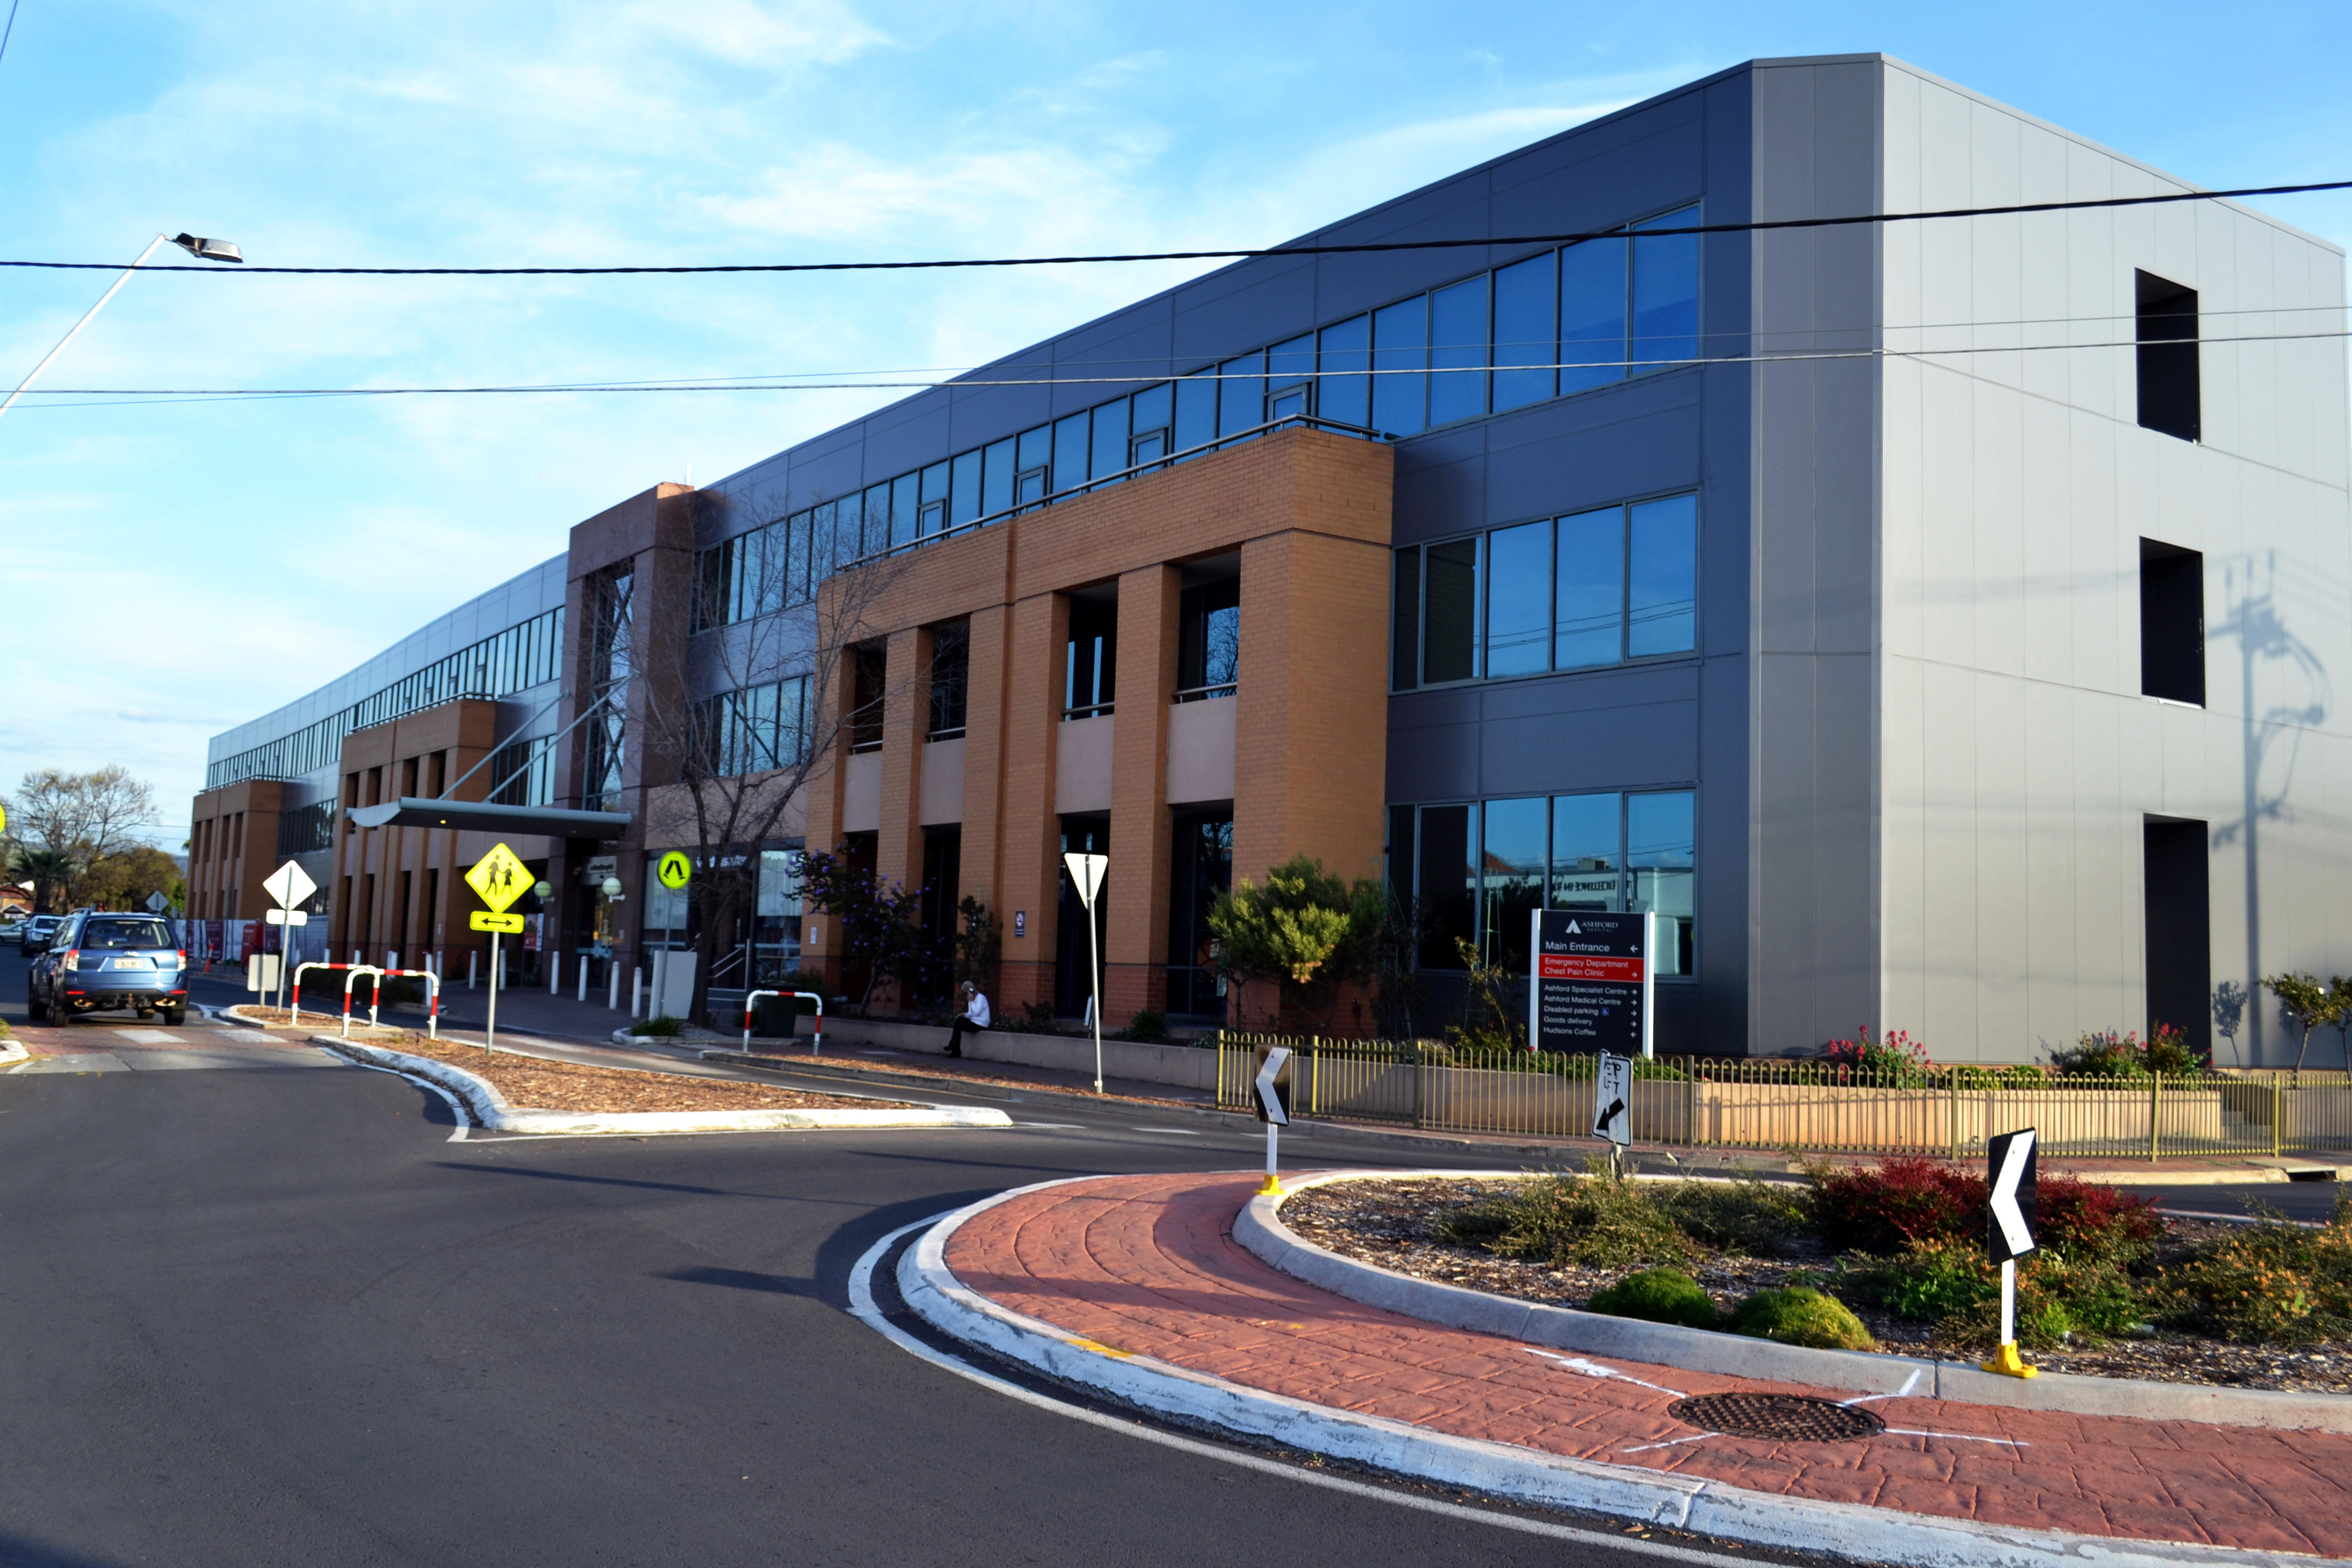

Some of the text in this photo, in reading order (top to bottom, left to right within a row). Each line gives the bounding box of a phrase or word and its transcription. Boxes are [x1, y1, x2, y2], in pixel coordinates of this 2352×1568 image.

[1545, 941, 1610, 952] Main Entrance
[1545, 957, 1628, 968] Emergency Department
[1585, 969, 1605, 977] Clinic
[1572, 986, 1603, 996] Specialist
[1574, 1007, 1599, 1016] parking
[1567, 1017, 1593, 1026] delivery
